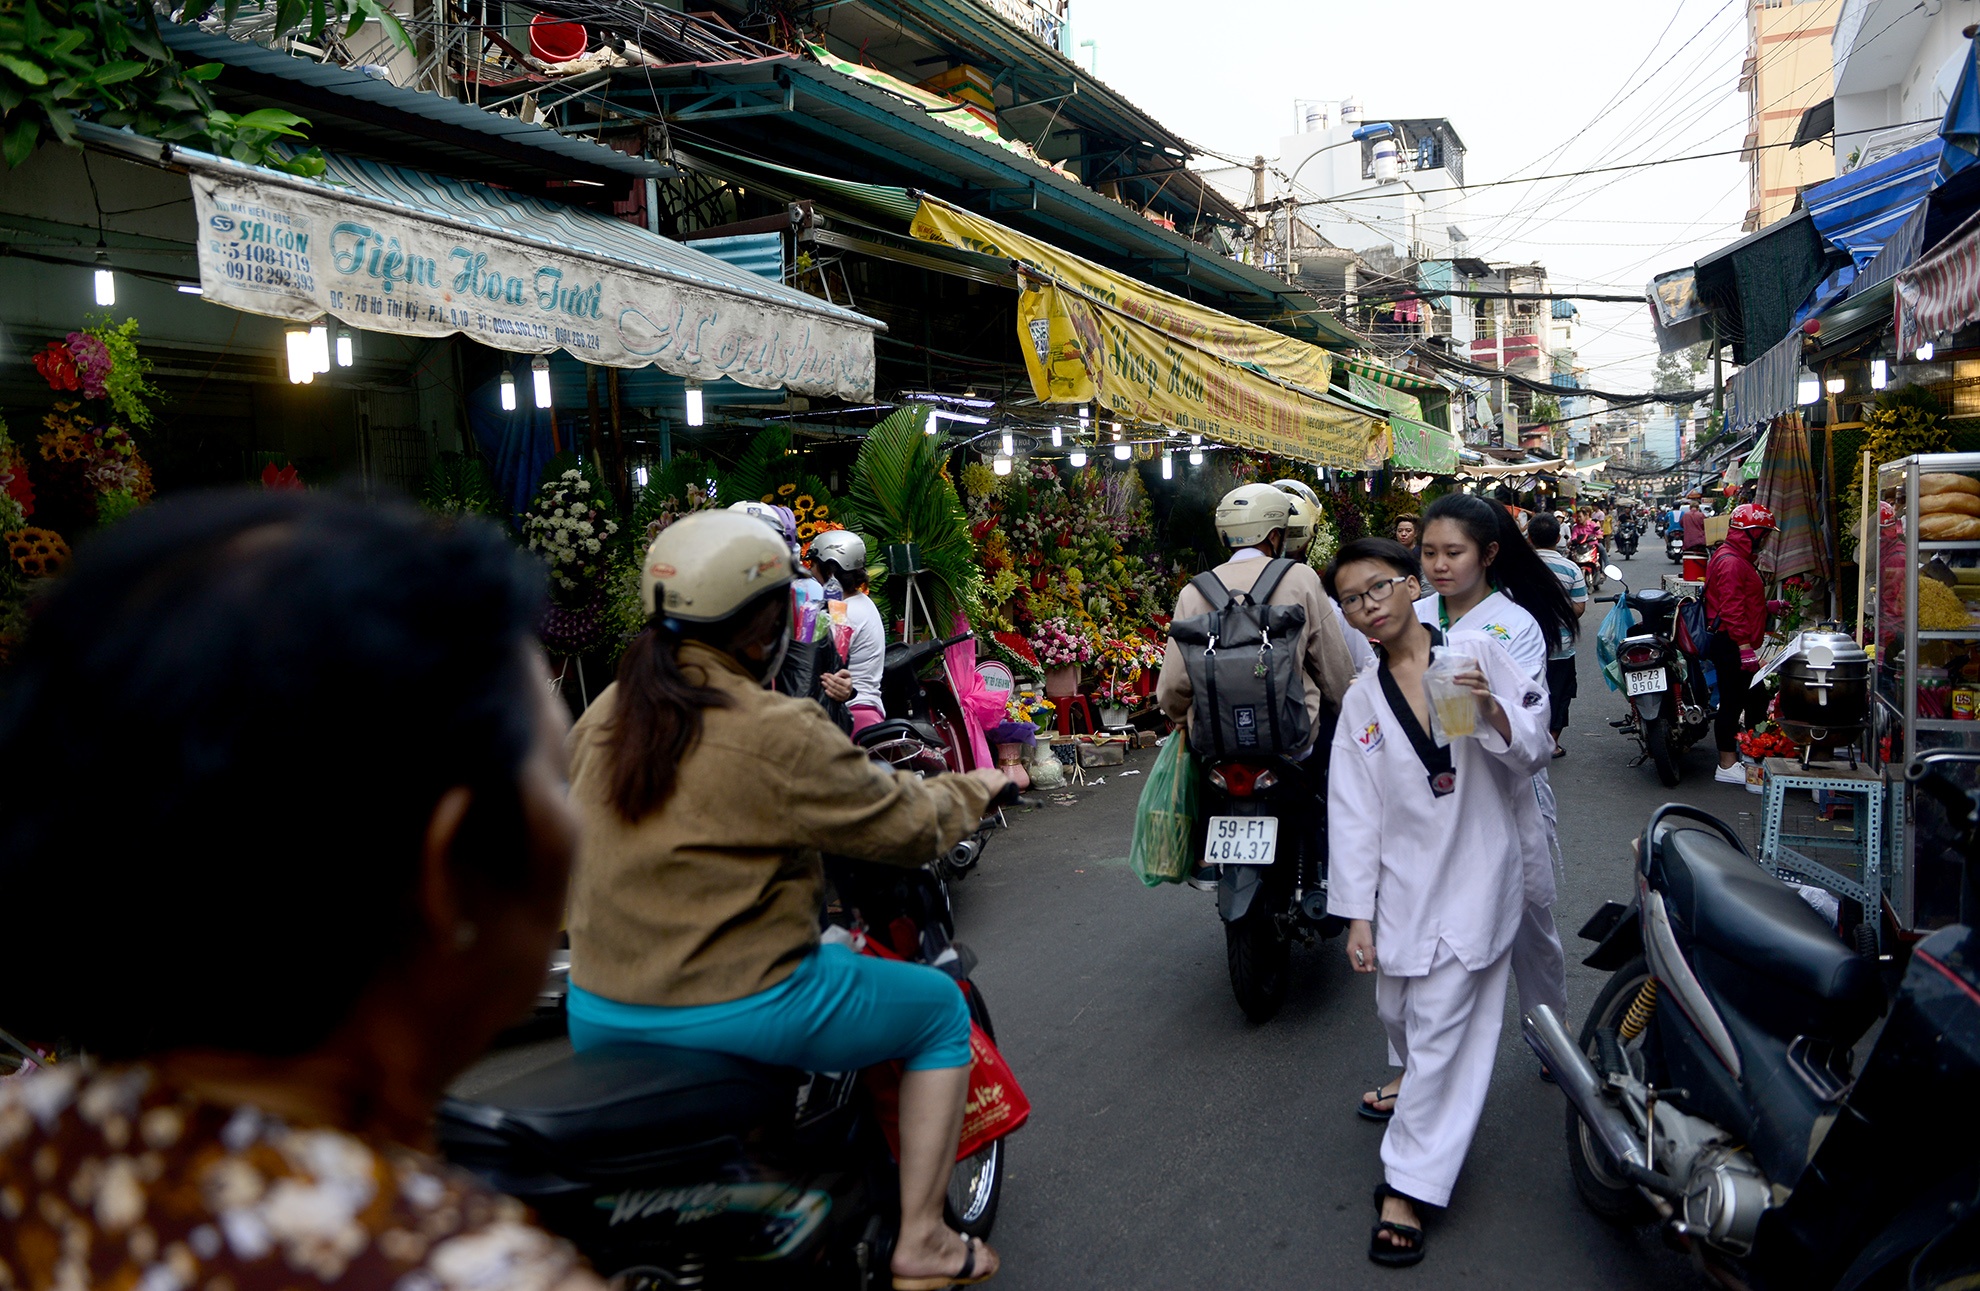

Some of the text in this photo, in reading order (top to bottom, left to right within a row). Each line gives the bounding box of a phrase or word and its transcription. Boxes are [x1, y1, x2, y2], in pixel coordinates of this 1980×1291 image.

[329, 220, 603, 321] Tiệm Hoa Tươi
[355, 294, 367, 313] 76
[371, 295, 383, 315] Hồ
[387, 298, 403, 321] Thị
[428, 304, 443, 323] P.1
[450, 308, 469, 328] Q.10
[1109, 324, 1159, 399] Shop
[1165, 345, 1204, 404] Hoa
[1135, 400, 1149, 417] 72
[1159, 407, 1173, 421] 74
[1631, 669, 1659, 682] 60-Z3
[1632, 679, 1661, 693] 9504
[1218, 820, 1265, 839] 59-F1
[1209, 840, 1271, 860] 484.37
